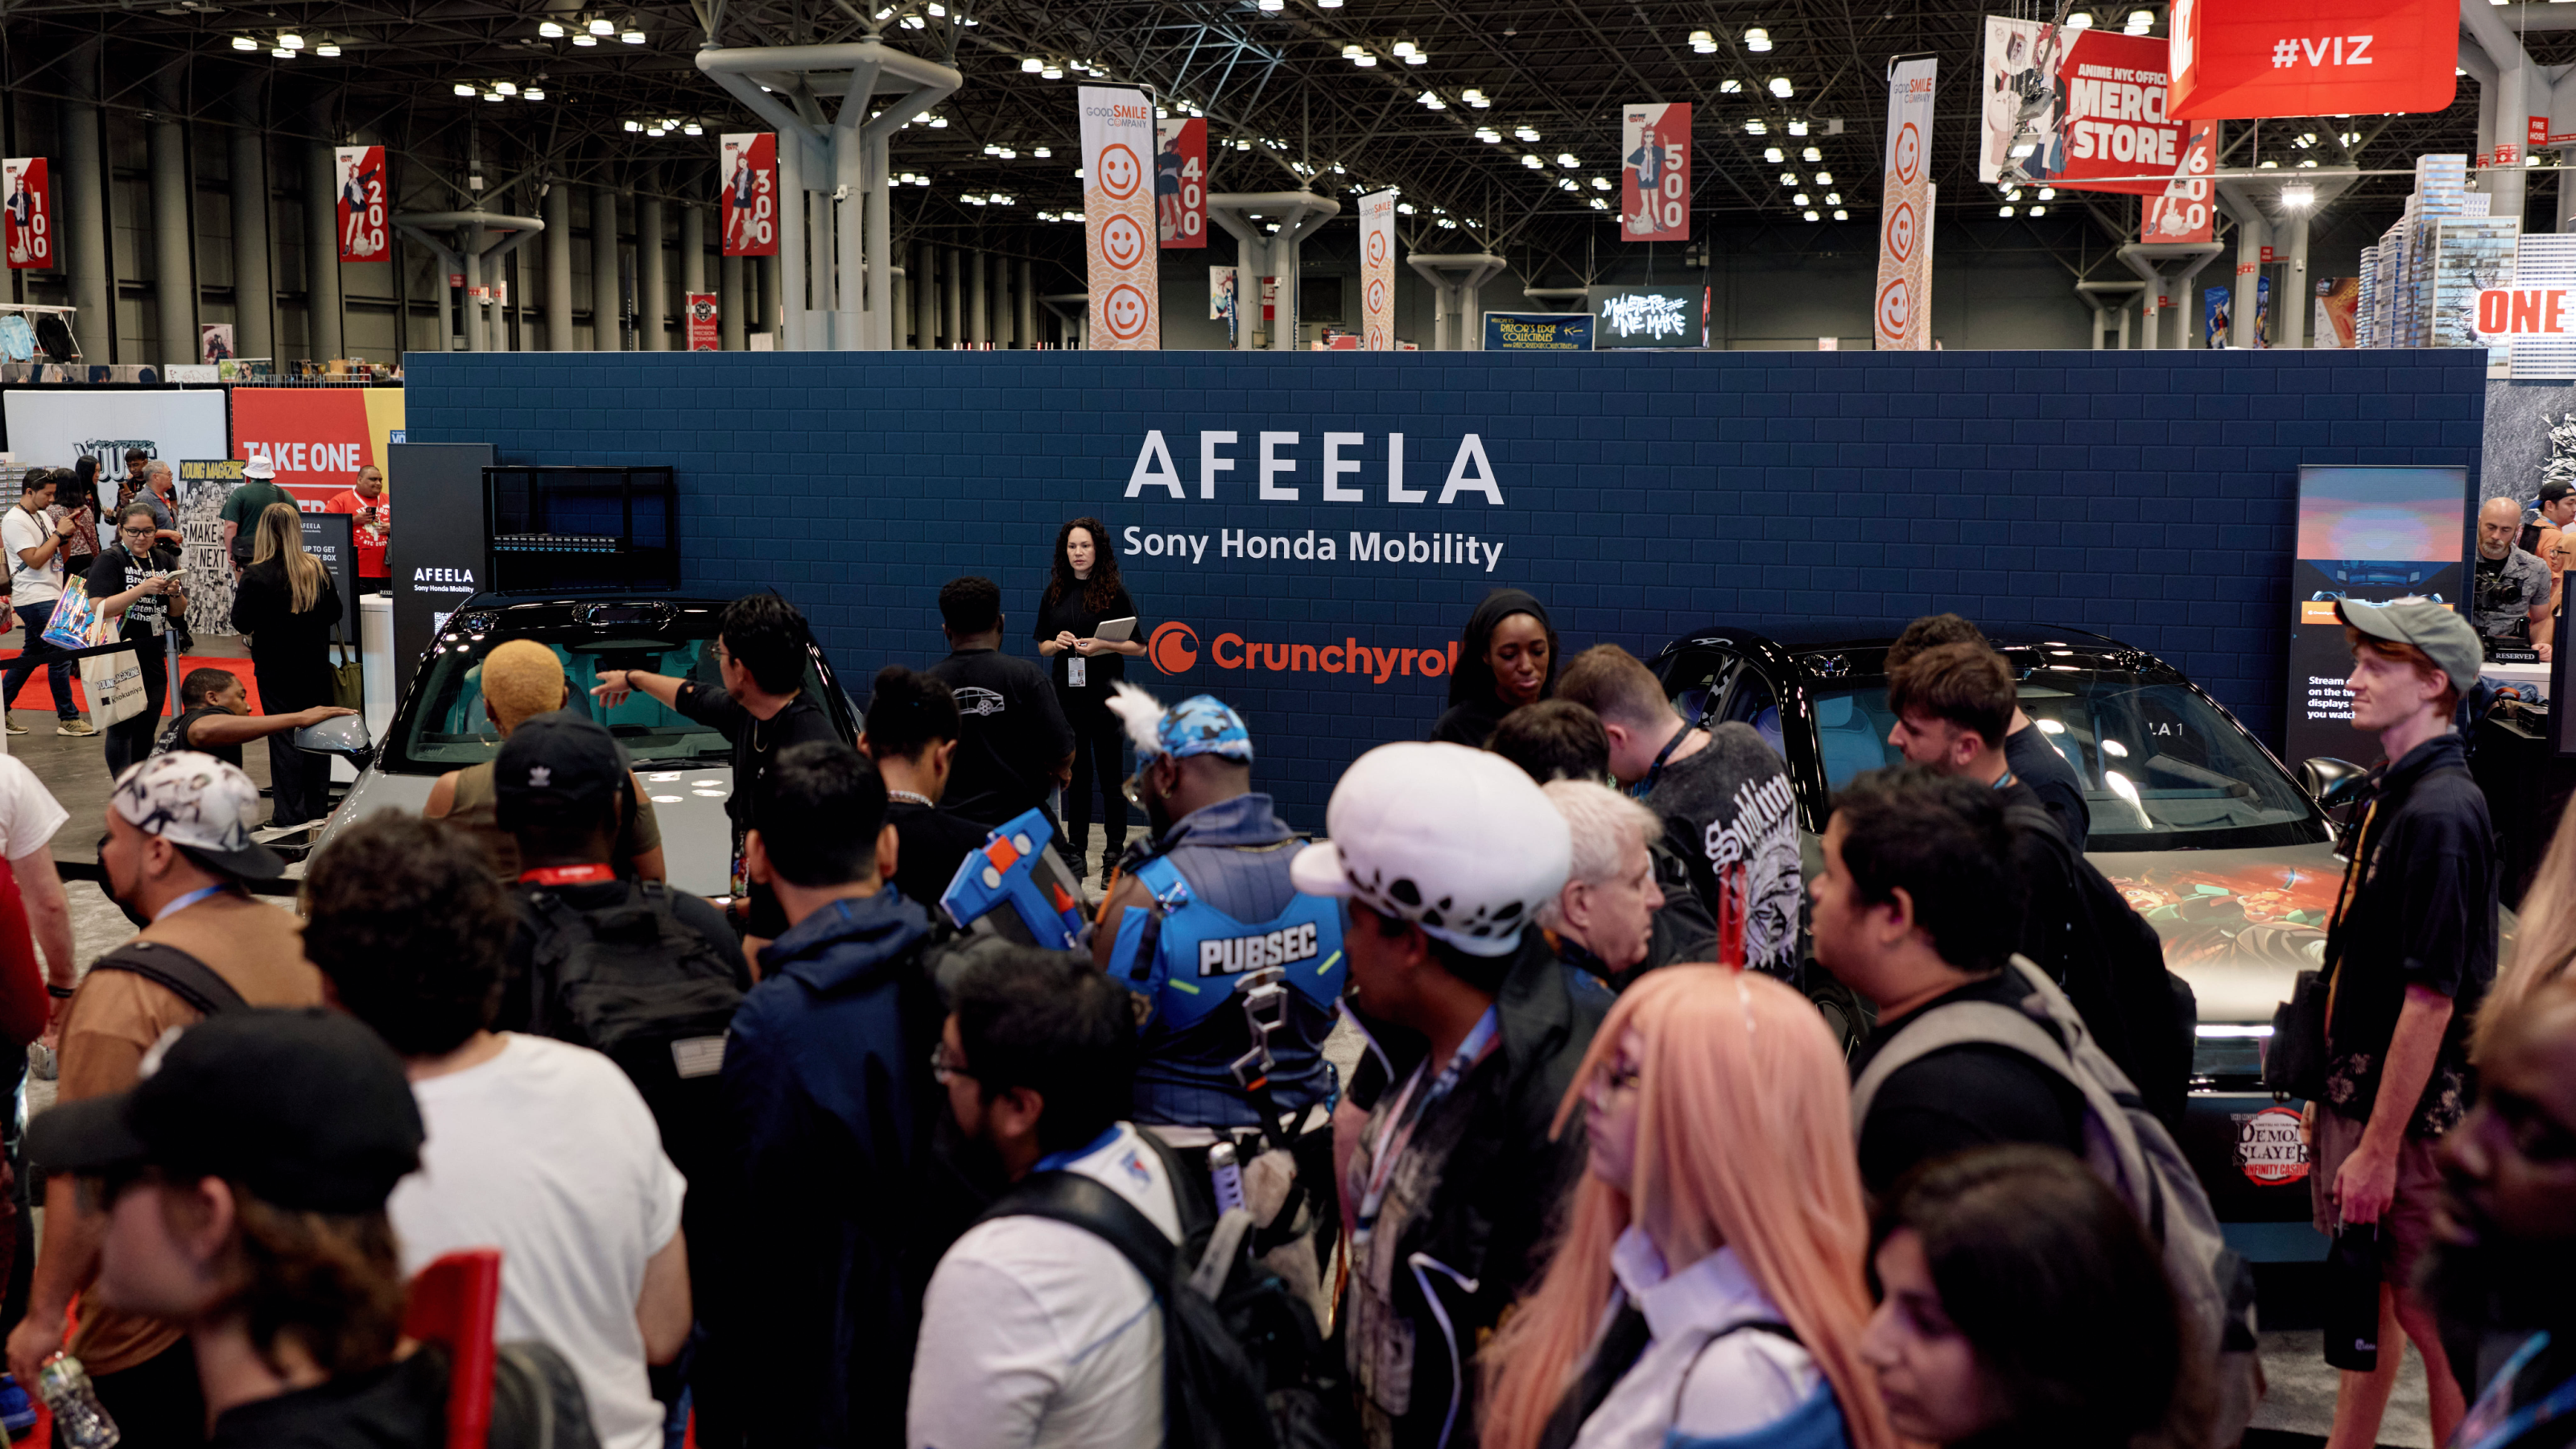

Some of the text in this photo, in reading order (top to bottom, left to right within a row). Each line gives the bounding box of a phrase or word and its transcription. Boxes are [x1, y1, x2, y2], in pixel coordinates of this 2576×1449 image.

[2273, 35, 2374, 68] #VIZ
[2078, 64, 2167, 85] ANIME NYC OFFICI
[1107, 118, 1146, 128] COMPANY
[2532, 121, 2545, 130] FIRE
[2073, 120, 2178, 166] STORE
[2529, 132, 2545, 141] HOSE
[1182, 157, 1203, 236] 400
[1664, 144, 1683, 228] 500
[2186, 147, 2208, 230] 600
[368, 180, 384, 251] 200
[756, 169, 772, 244] 300
[33, 192, 47, 258] 100
[2478, 290, 2567, 333] ONE
[1500, 324, 1556, 333] RAZOR'S EDGE
[1503, 332, 1553, 342] COLLECTIBLES
[1619, 312, 1645, 338] WE
[1646, 312, 1686, 340] MAKE
[311, 443, 361, 472] ONE
[1124, 429, 1505, 506] AFEELA
[180, 461, 244, 480] YOUNG MAGAZINE
[189, 523, 217, 543] MAKE
[199, 548, 226, 568] NEXT
[1123, 526, 1505, 572] Sony Honda Mobility
[414, 568, 474, 582] AFEELA
[414, 584, 428, 592] Sony
[1212, 632, 1465, 683] Crunchyrol
[2309, 676, 2344, 685] Stream
[2323, 688, 2341, 696] the
[2308, 699, 2349, 709] displays
[2177, 723, 2182, 736] 1
[1199, 922, 1318, 976] PUBSEC
[2231, 1143, 2310, 1167] SLAYER
[2246, 1162, 2310, 1176] INFINITY CASTLE
